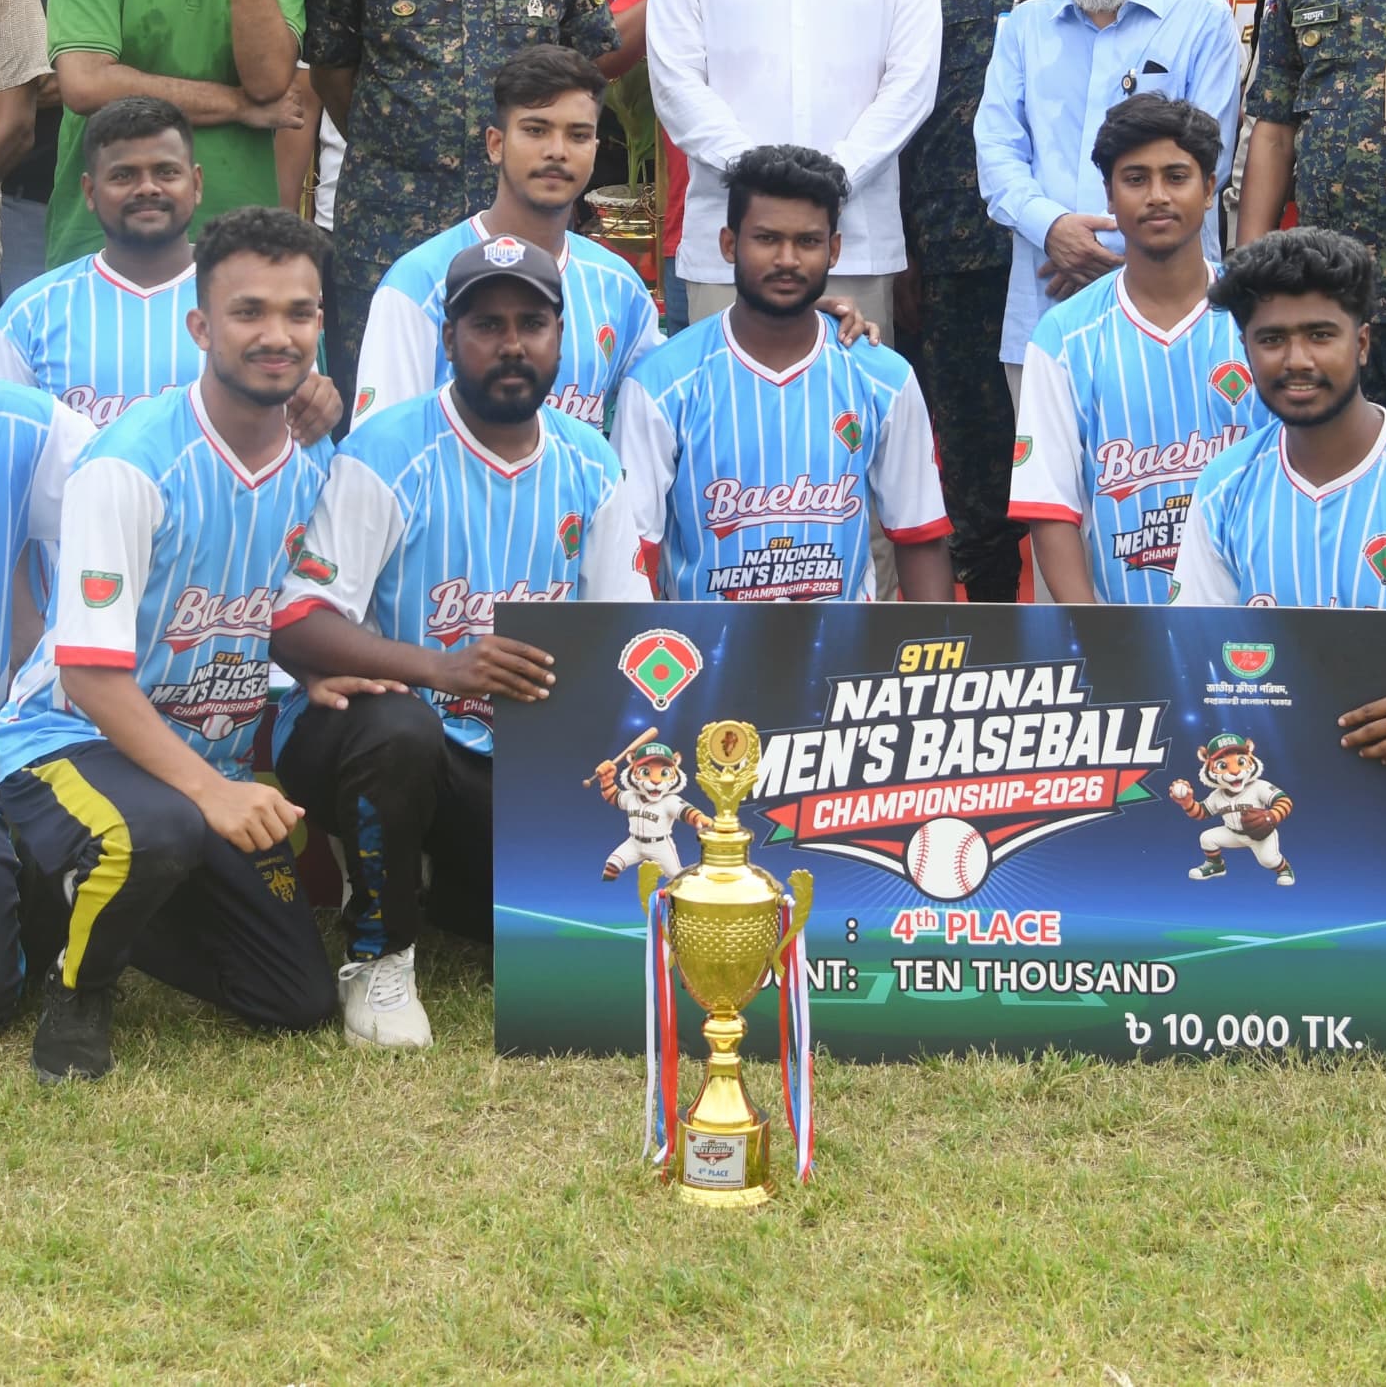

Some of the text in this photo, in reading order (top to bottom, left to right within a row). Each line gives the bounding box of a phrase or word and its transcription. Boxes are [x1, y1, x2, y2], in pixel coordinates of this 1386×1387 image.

[1144, 507, 1188, 526] NATI
[1166, 496, 1191, 509] 9TH
[745, 545, 833, 566] NATIONAL
[770, 538, 792, 549] 9TH
[1115, 526, 1169, 558] MEN'S
[709, 560, 843, 591] MEN'S BASEBA
[194, 661, 268, 683] NATIONA
[214, 652, 243, 664] 9TH
[899, 642, 967, 674] 9TH
[149, 678, 268, 705] MEN'S BASEB
[830, 664, 1085, 723] NATIONAL
[173, 699, 266, 717] CHAMPIONSHIP-2
[905, 706, 1165, 781] BASEBALL
[812, 775, 1104, 831] CHAMPIONSHIP-2026
[891, 910, 938, 945] 4th
[945, 910, 1061, 945] PLACE
[892, 960, 962, 991] TEN
[973, 960, 1176, 994] THOUSAND
[1162, 1014, 1290, 1052] 10,000
[1301, 1015, 1365, 1050] TK.
[708, 1169, 729, 1177] PLACE
